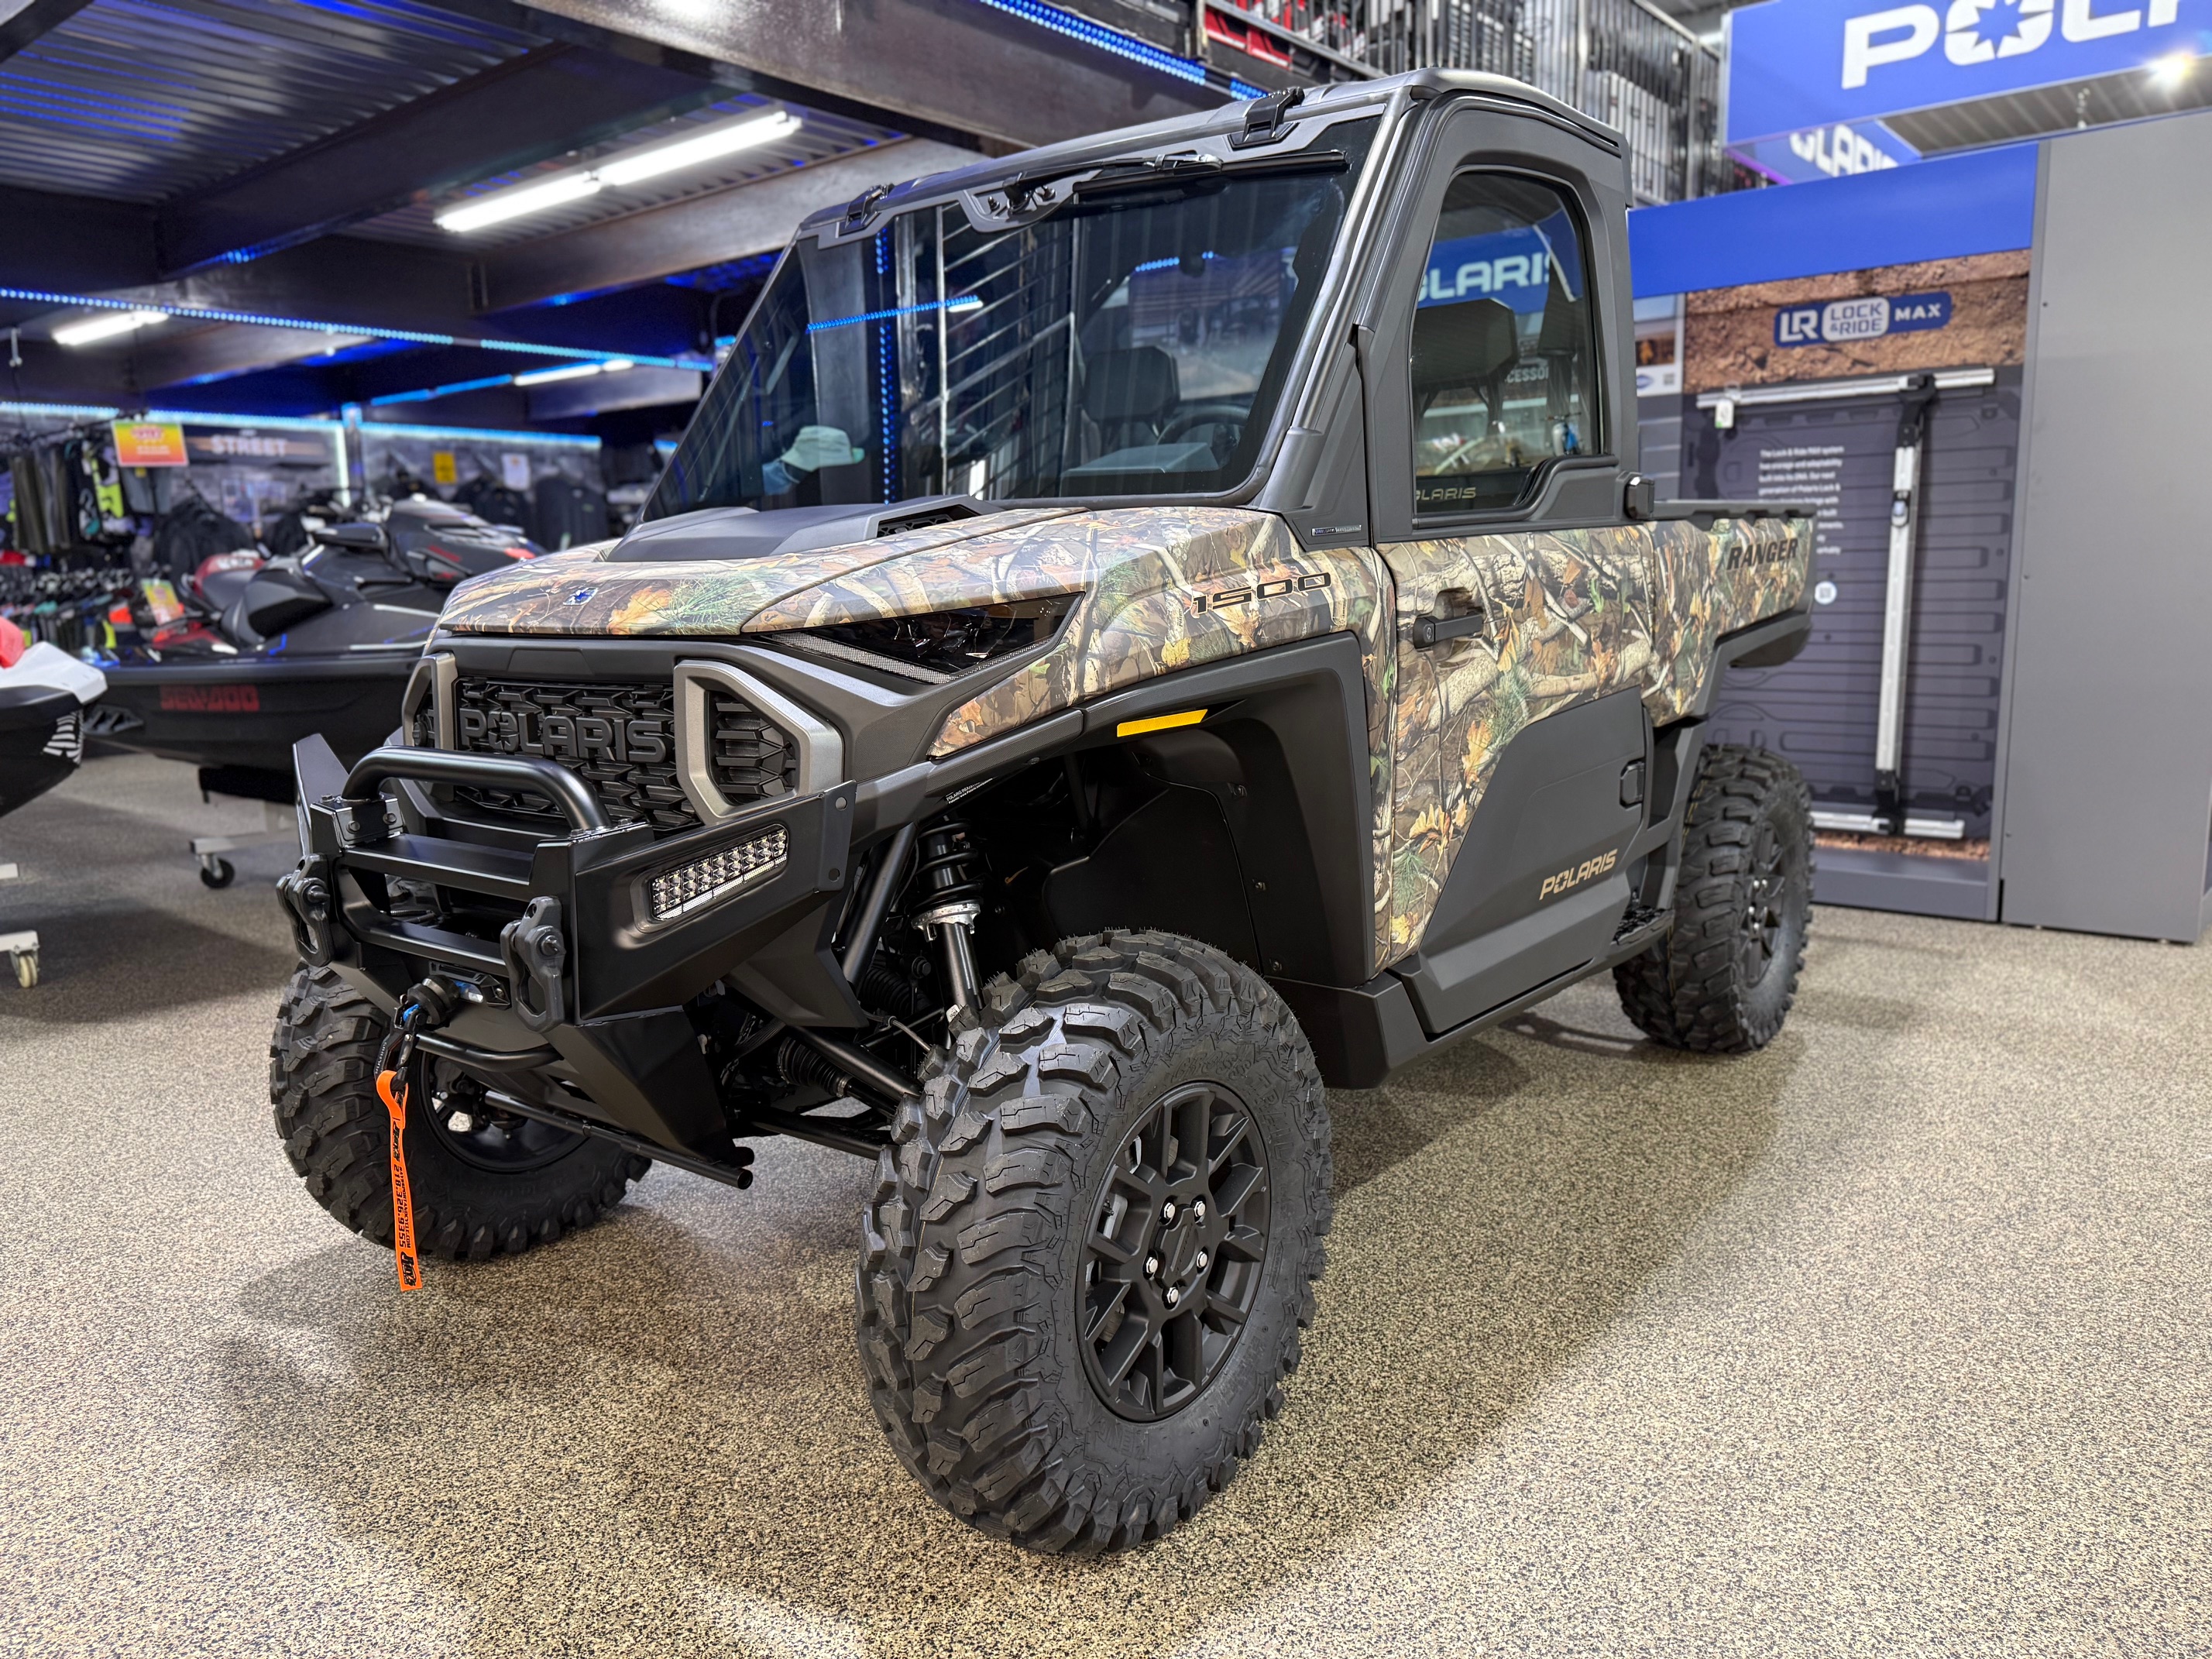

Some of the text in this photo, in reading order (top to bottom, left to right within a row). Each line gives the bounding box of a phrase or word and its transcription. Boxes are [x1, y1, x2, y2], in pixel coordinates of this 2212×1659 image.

[1842, 0, 2178, 90] POL
[1416, 252, 1551, 302] LARI
[1830, 302, 1883, 321] LOCK
[1894, 303, 1942, 322] MAX
[1505, 366, 1549, 383] CESSO
[1726, 538, 1798, 571] RANGER
[1193, 572, 1331, 614] 1500
[459, 706, 672, 764] POLARIS
[1538, 848, 1619, 901] POLARIS
[393, 1163, 407, 1249] 218.326.9355
